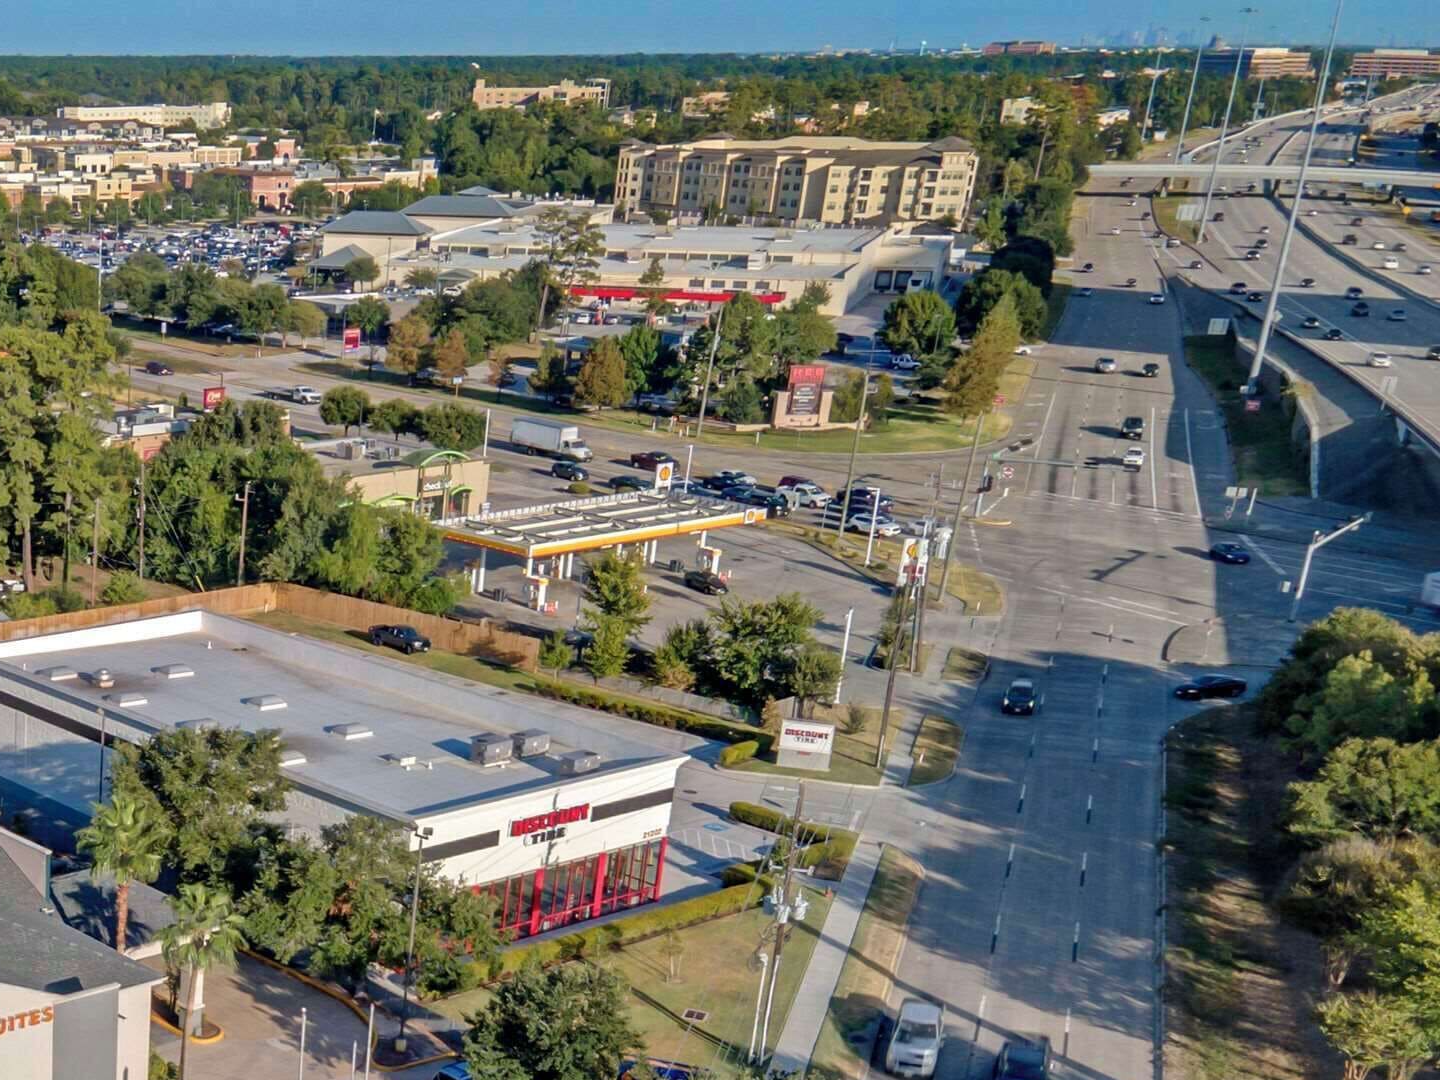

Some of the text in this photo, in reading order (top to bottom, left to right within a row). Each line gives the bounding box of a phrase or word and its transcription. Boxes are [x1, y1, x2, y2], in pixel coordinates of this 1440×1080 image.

[785, 728, 829, 740] DISCOUNT
[796, 736, 816, 744] TIRE
[510, 803, 590, 837] DISCOUNT
[531, 827, 566, 844] TIRE
